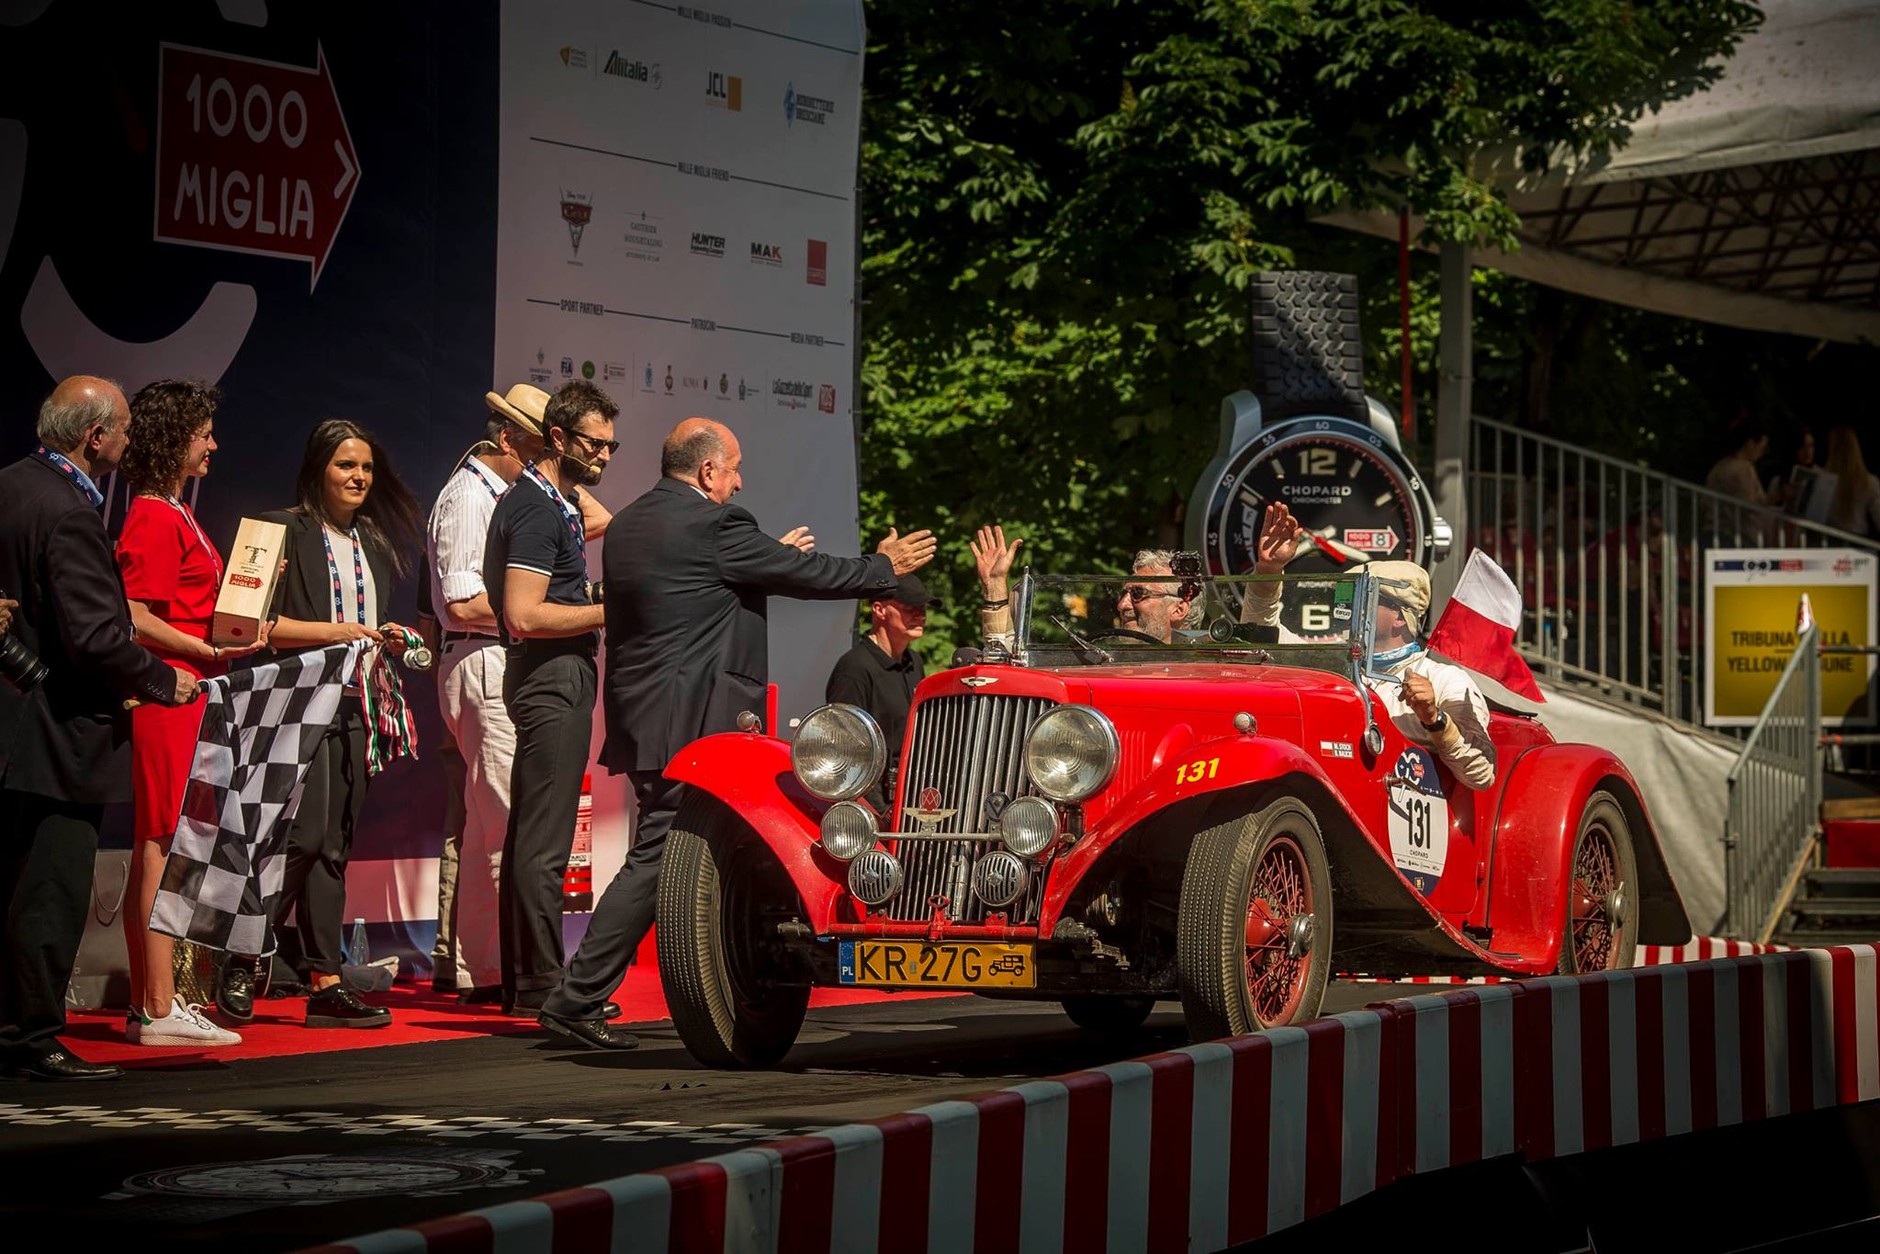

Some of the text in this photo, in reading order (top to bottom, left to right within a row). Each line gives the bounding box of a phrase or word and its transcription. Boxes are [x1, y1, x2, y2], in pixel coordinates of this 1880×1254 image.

[603, 49, 648, 82] Alitalia
[706, 71, 726, 99] JCL
[186, 73, 308, 149] 1000
[174, 162, 315, 240] MIGLIA
[690, 232, 725, 249] HUNTER
[750, 242, 782, 259] MAK
[560, 299, 604, 316] SPORT PARTNER
[1315, 420, 1330, 430] 60
[1262, 433, 1276, 447] 55
[1368, 434, 1382, 448] 05
[1297, 448, 1337, 476] 12
[1223, 473, 1236, 489] 50
[1408, 475, 1421, 491] 10
[1281, 485, 1352, 497] CHOPARD
[1208, 531, 1218, 546] 45
[1376, 533, 1386, 546] 8
[234, 575, 256, 583] 1000
[1302, 604, 1331, 631] 6
[1731, 631, 1794, 646] TRIBUNA
[1727, 657, 1786, 672] YELLOW
[1175, 758, 1220, 785] 131
[1406, 797, 1431, 850] 131
[1409, 849, 1429, 859] CHOPARD
[841, 966, 854, 976] PL
[859, 946, 982, 982] KR 27G
